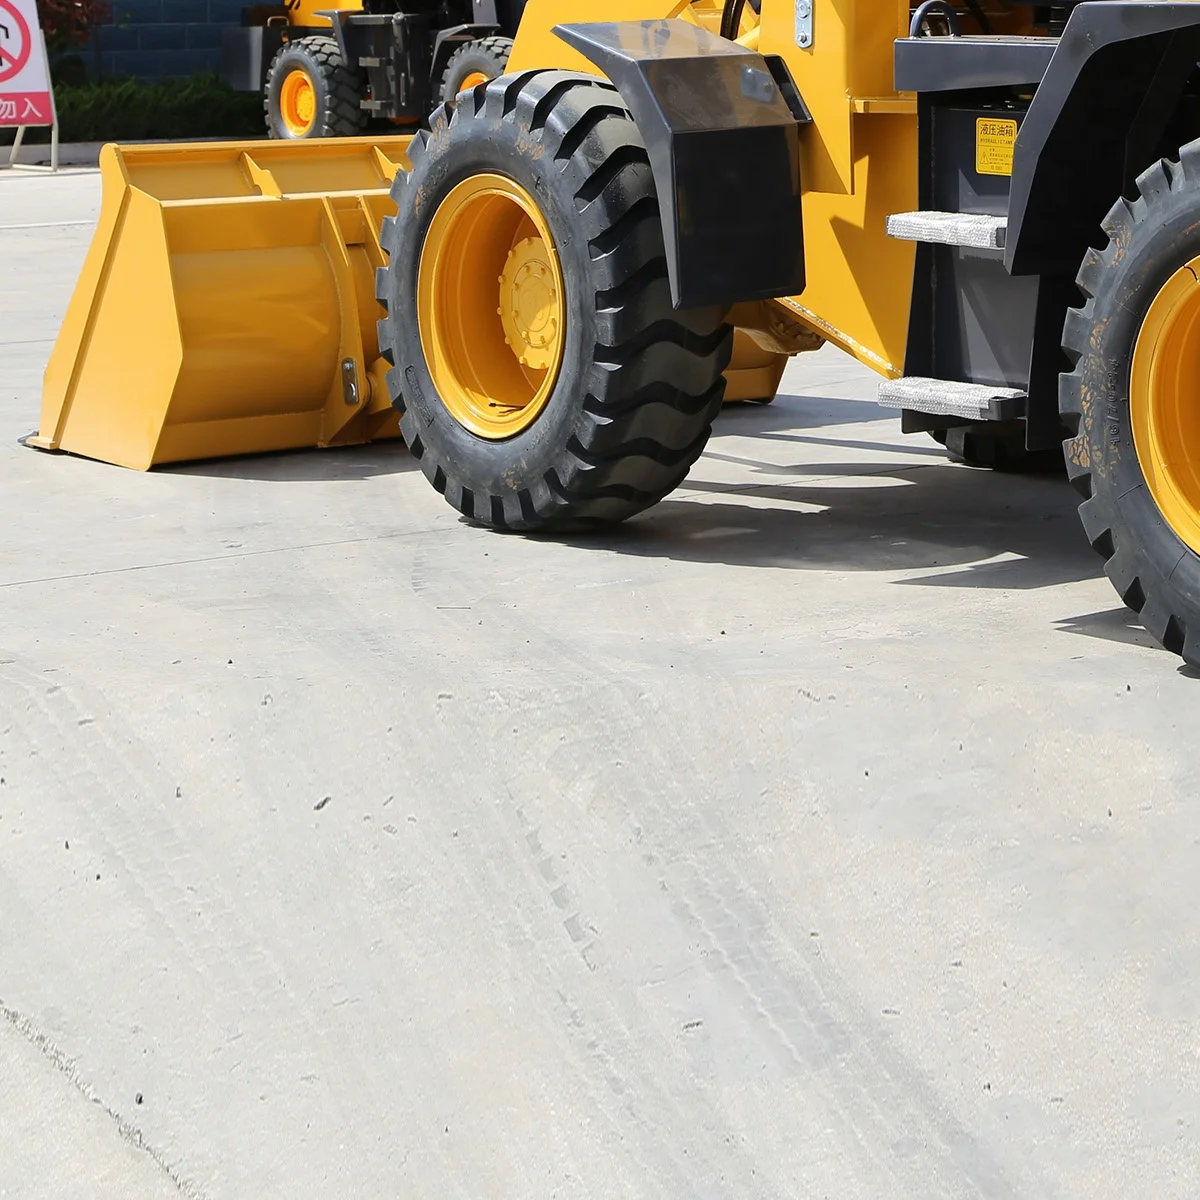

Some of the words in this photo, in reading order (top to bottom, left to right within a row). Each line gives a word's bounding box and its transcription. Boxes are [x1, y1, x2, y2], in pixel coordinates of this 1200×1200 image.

[0, 97, 43, 119] 勿入
[980, 123, 1013, 137] 液压油箱
